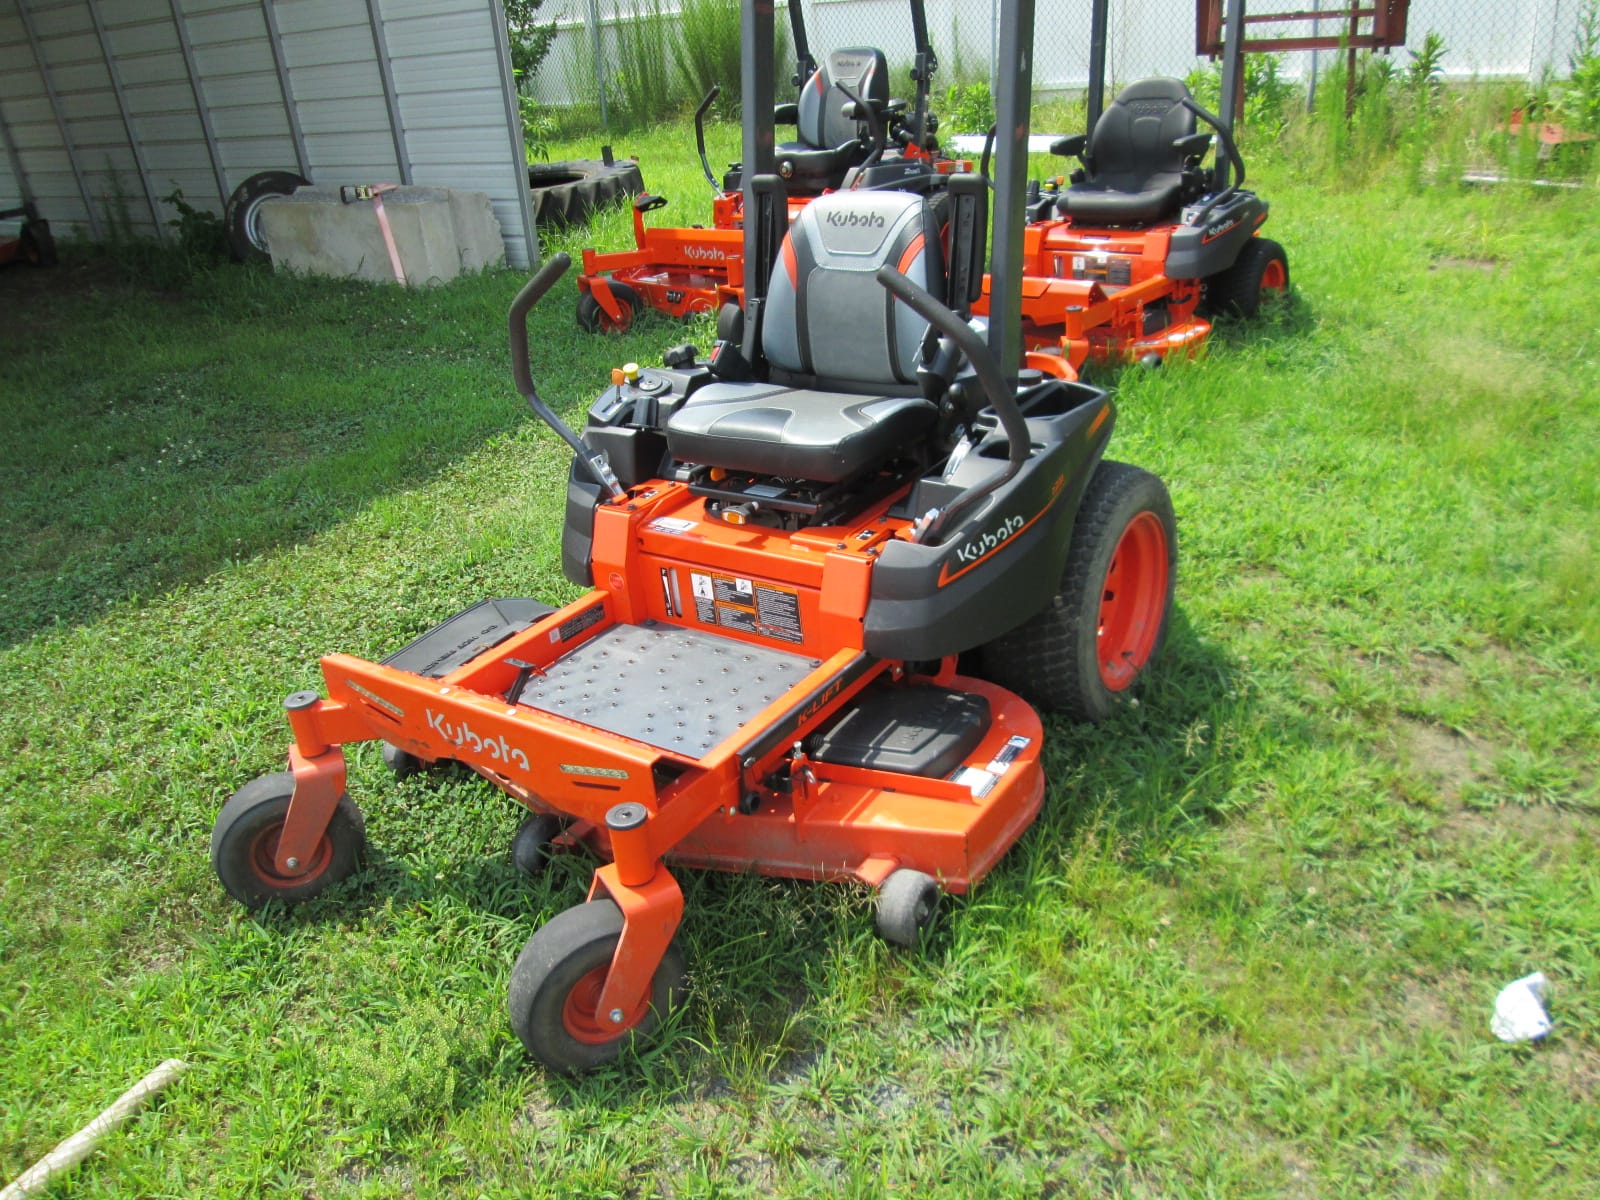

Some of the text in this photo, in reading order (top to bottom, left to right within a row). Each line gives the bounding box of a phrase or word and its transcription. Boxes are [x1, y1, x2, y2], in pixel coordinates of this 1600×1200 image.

[826, 210, 885, 228] Kubota
[684, 244, 725, 261] Kubota
[957, 514, 1025, 562] Kubota
[797, 677, 844, 727] K-LIFT
[425, 708, 530, 772] Kubota
